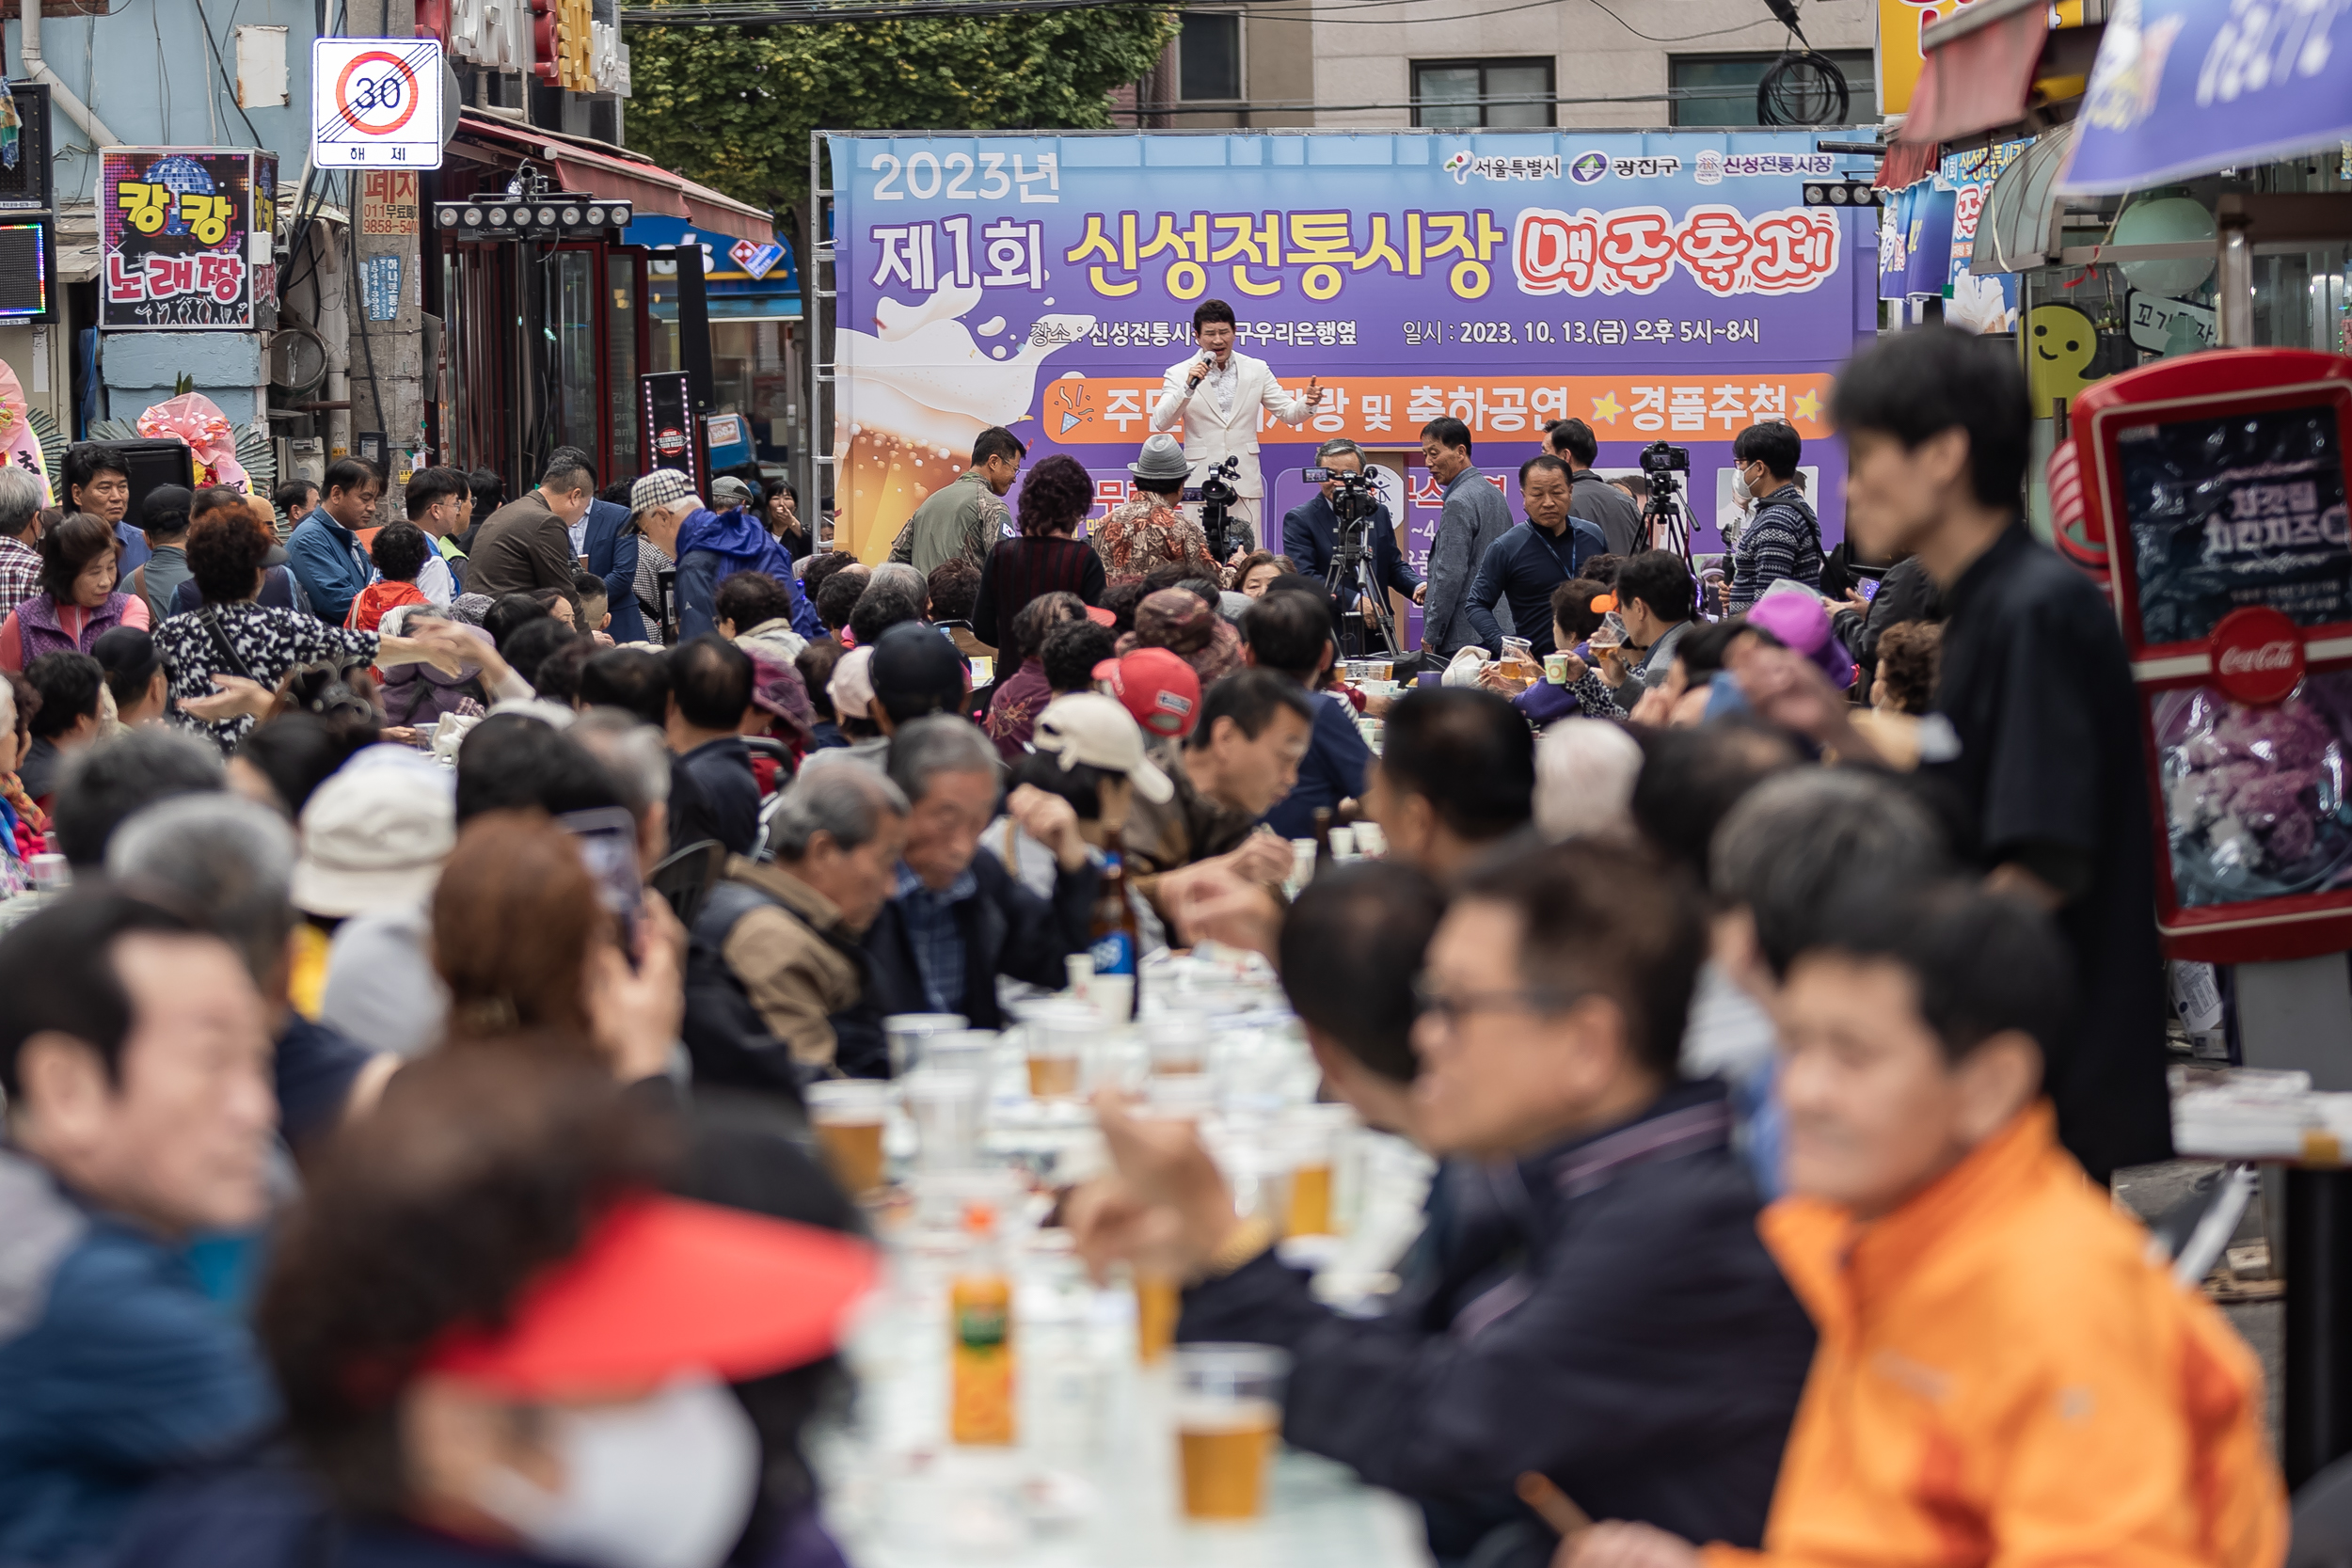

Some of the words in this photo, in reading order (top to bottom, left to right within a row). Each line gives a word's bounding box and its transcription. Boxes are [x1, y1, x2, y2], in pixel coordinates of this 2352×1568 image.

[357, 78, 400, 108] 30
[871, 151, 1059, 203] 2023년
[1475, 157, 1559, 179] 서울특별시
[1613, 158, 1679, 177] 광진구
[1723, 155, 1833, 175] 신성전통시장
[872, 217, 1042, 290] 제1회
[1067, 213, 1503, 300] 신성전통시장
[1515, 207, 1838, 295] 맥주축제
[1029, 322, 1072, 346] 장소
[1403, 320, 1442, 345] 일시
[1459, 322, 1518, 345] 2023.
[1523, 321, 1556, 344] 10.
[1632, 318, 1676, 344] 오후
[1679, 318, 1760, 344] 5시~8시
[1361, 395, 1391, 432] 및
[1406, 387, 1568, 433] 축하공연
[1629, 385, 1787, 431] 경품추첨
